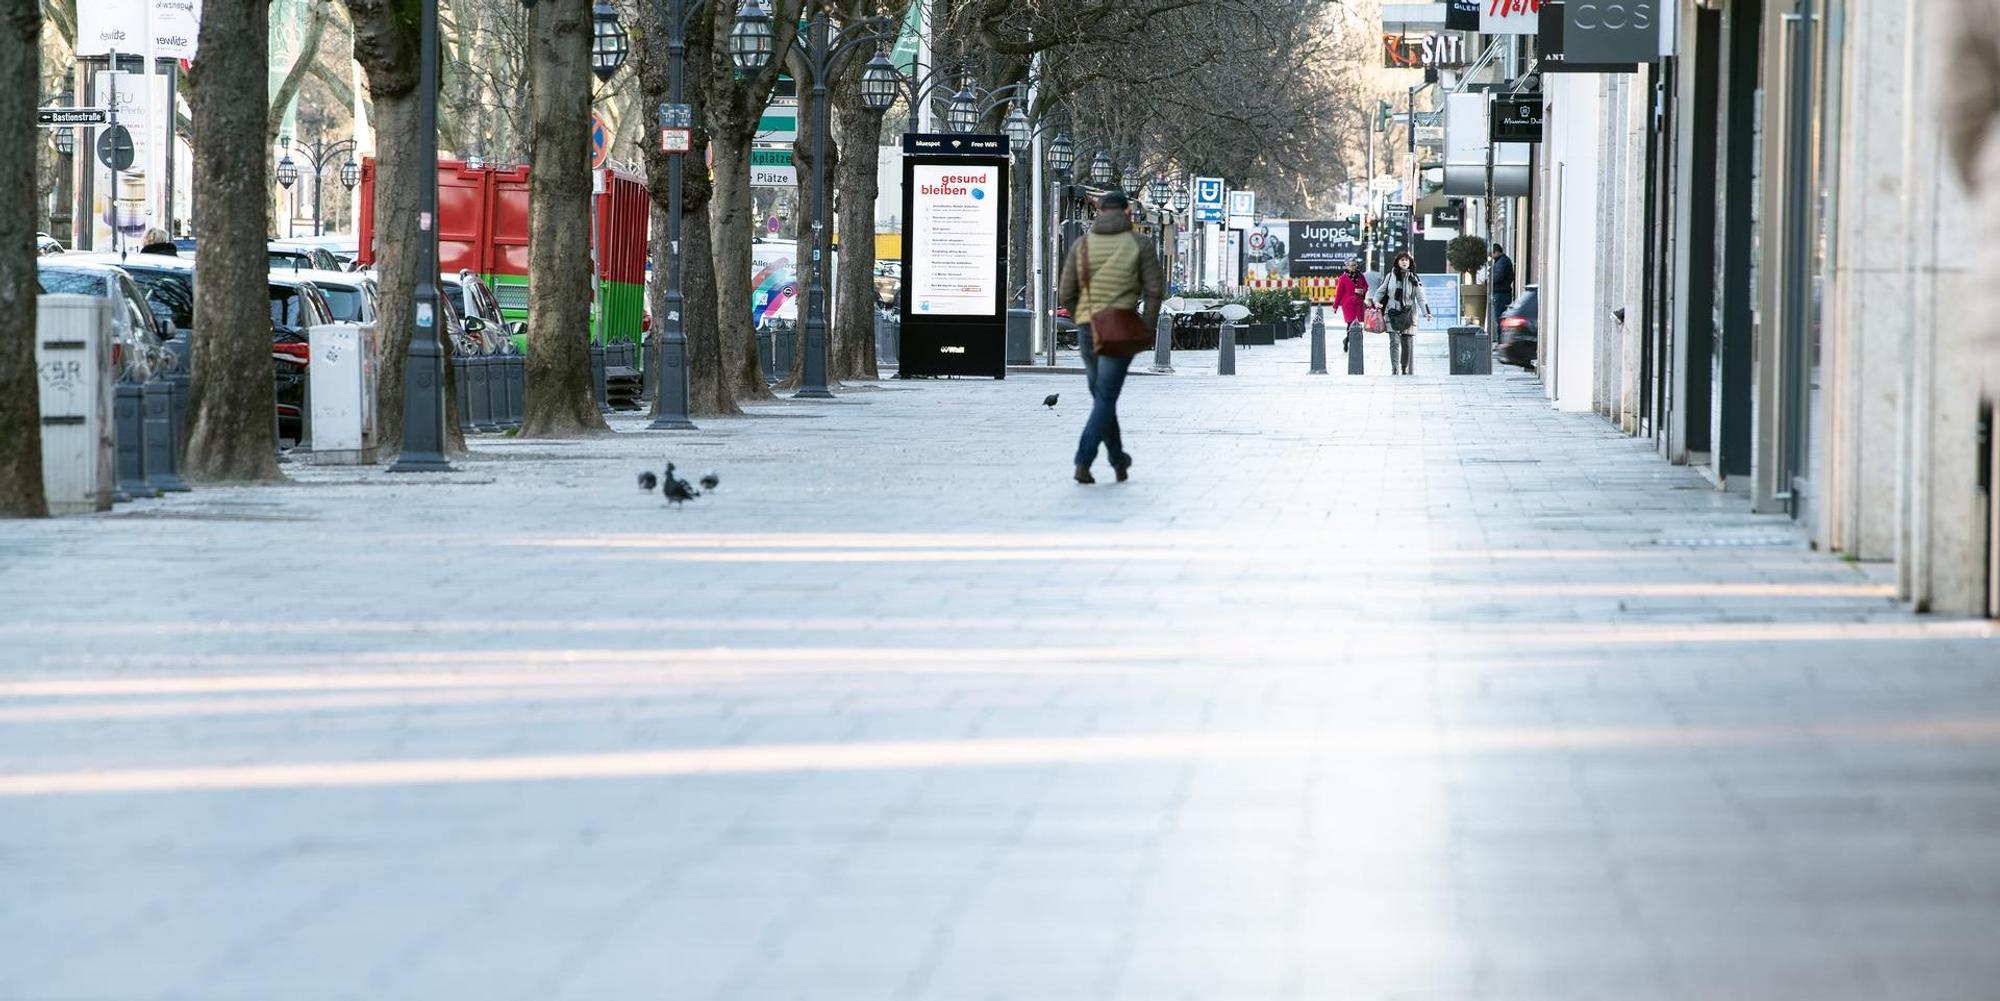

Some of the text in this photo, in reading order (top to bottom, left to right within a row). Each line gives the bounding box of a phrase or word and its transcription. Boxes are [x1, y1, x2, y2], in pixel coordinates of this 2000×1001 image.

[1574, 4, 1650, 29] COS
[52, 112, 102, 122] Bastionstraße
[752, 151, 793, 165] kplätze
[757, 174, 789, 183] Plätze
[941, 173, 987, 186] gesund
[921, 184, 967, 195] bleiben
[1300, 224, 1352, 242] Juppe
